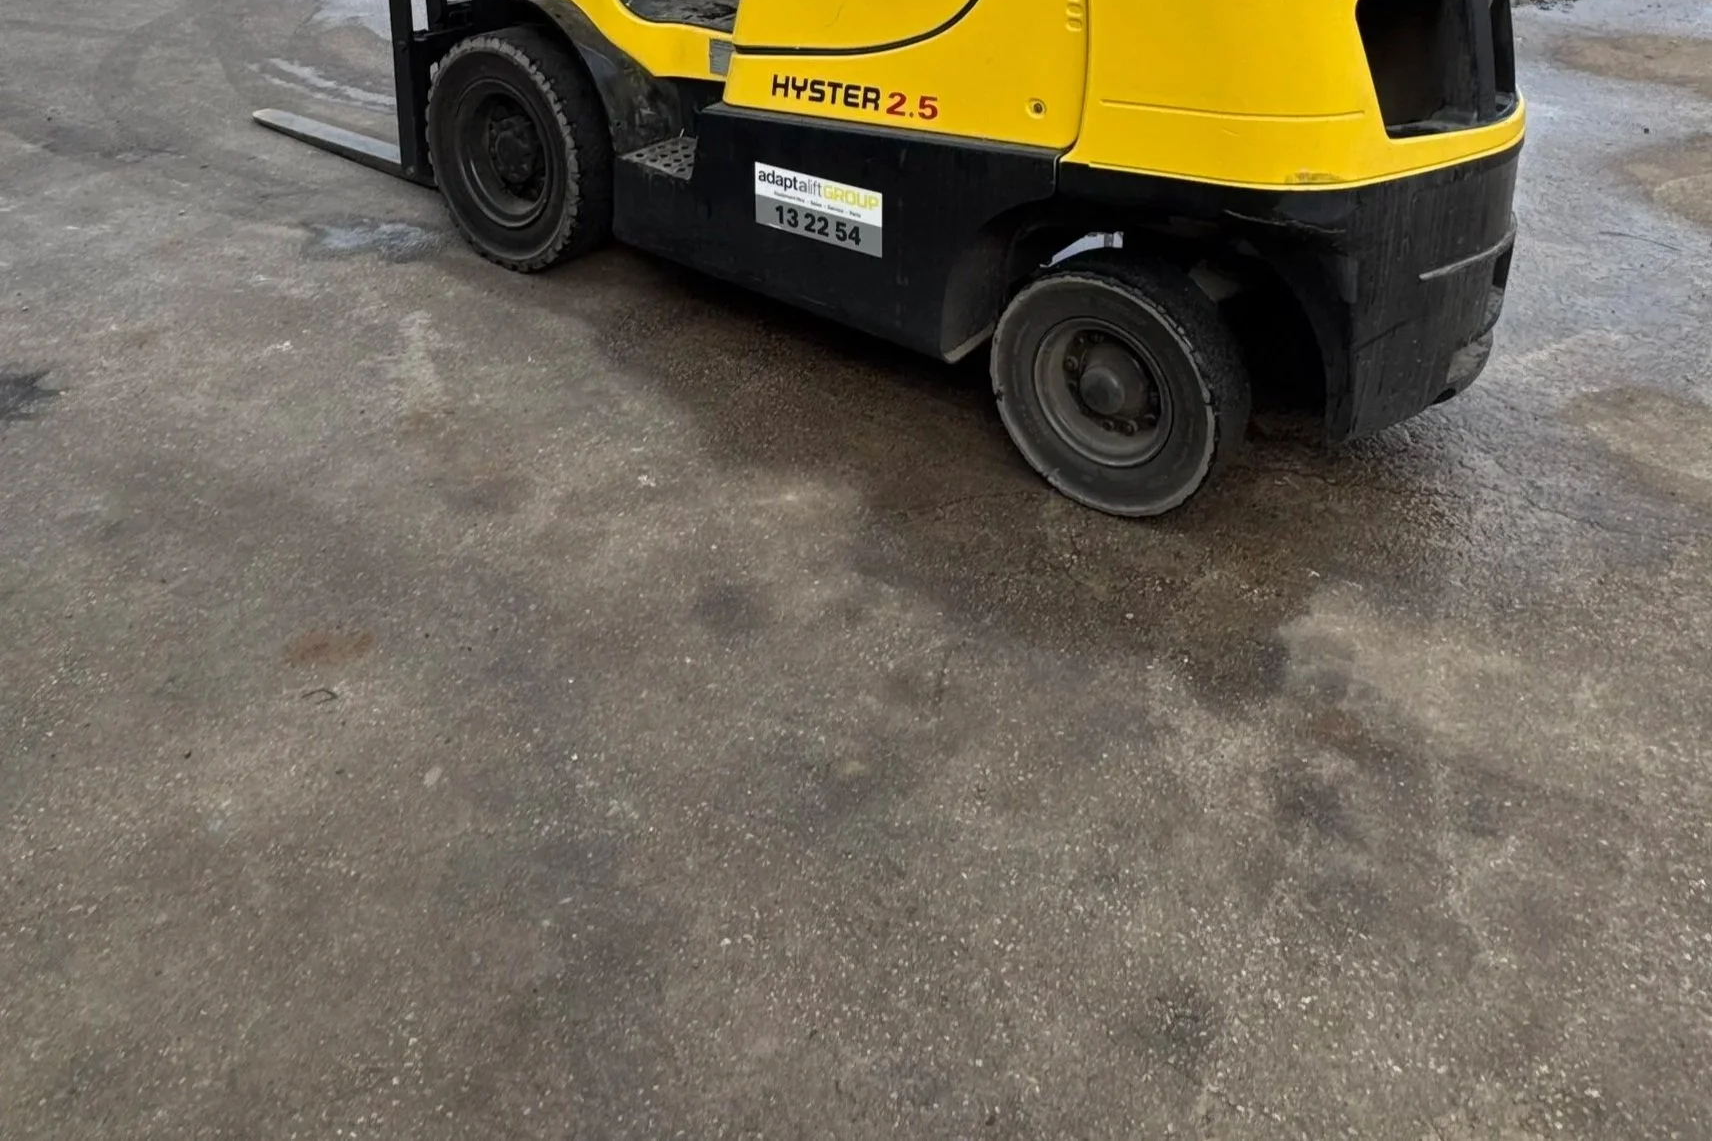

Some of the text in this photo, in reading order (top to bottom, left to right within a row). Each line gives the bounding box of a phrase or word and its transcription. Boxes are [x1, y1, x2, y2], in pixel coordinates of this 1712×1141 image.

[772, 74, 939, 120] HYSTER 2.5
[775, 205, 861, 246] 13 22 54
